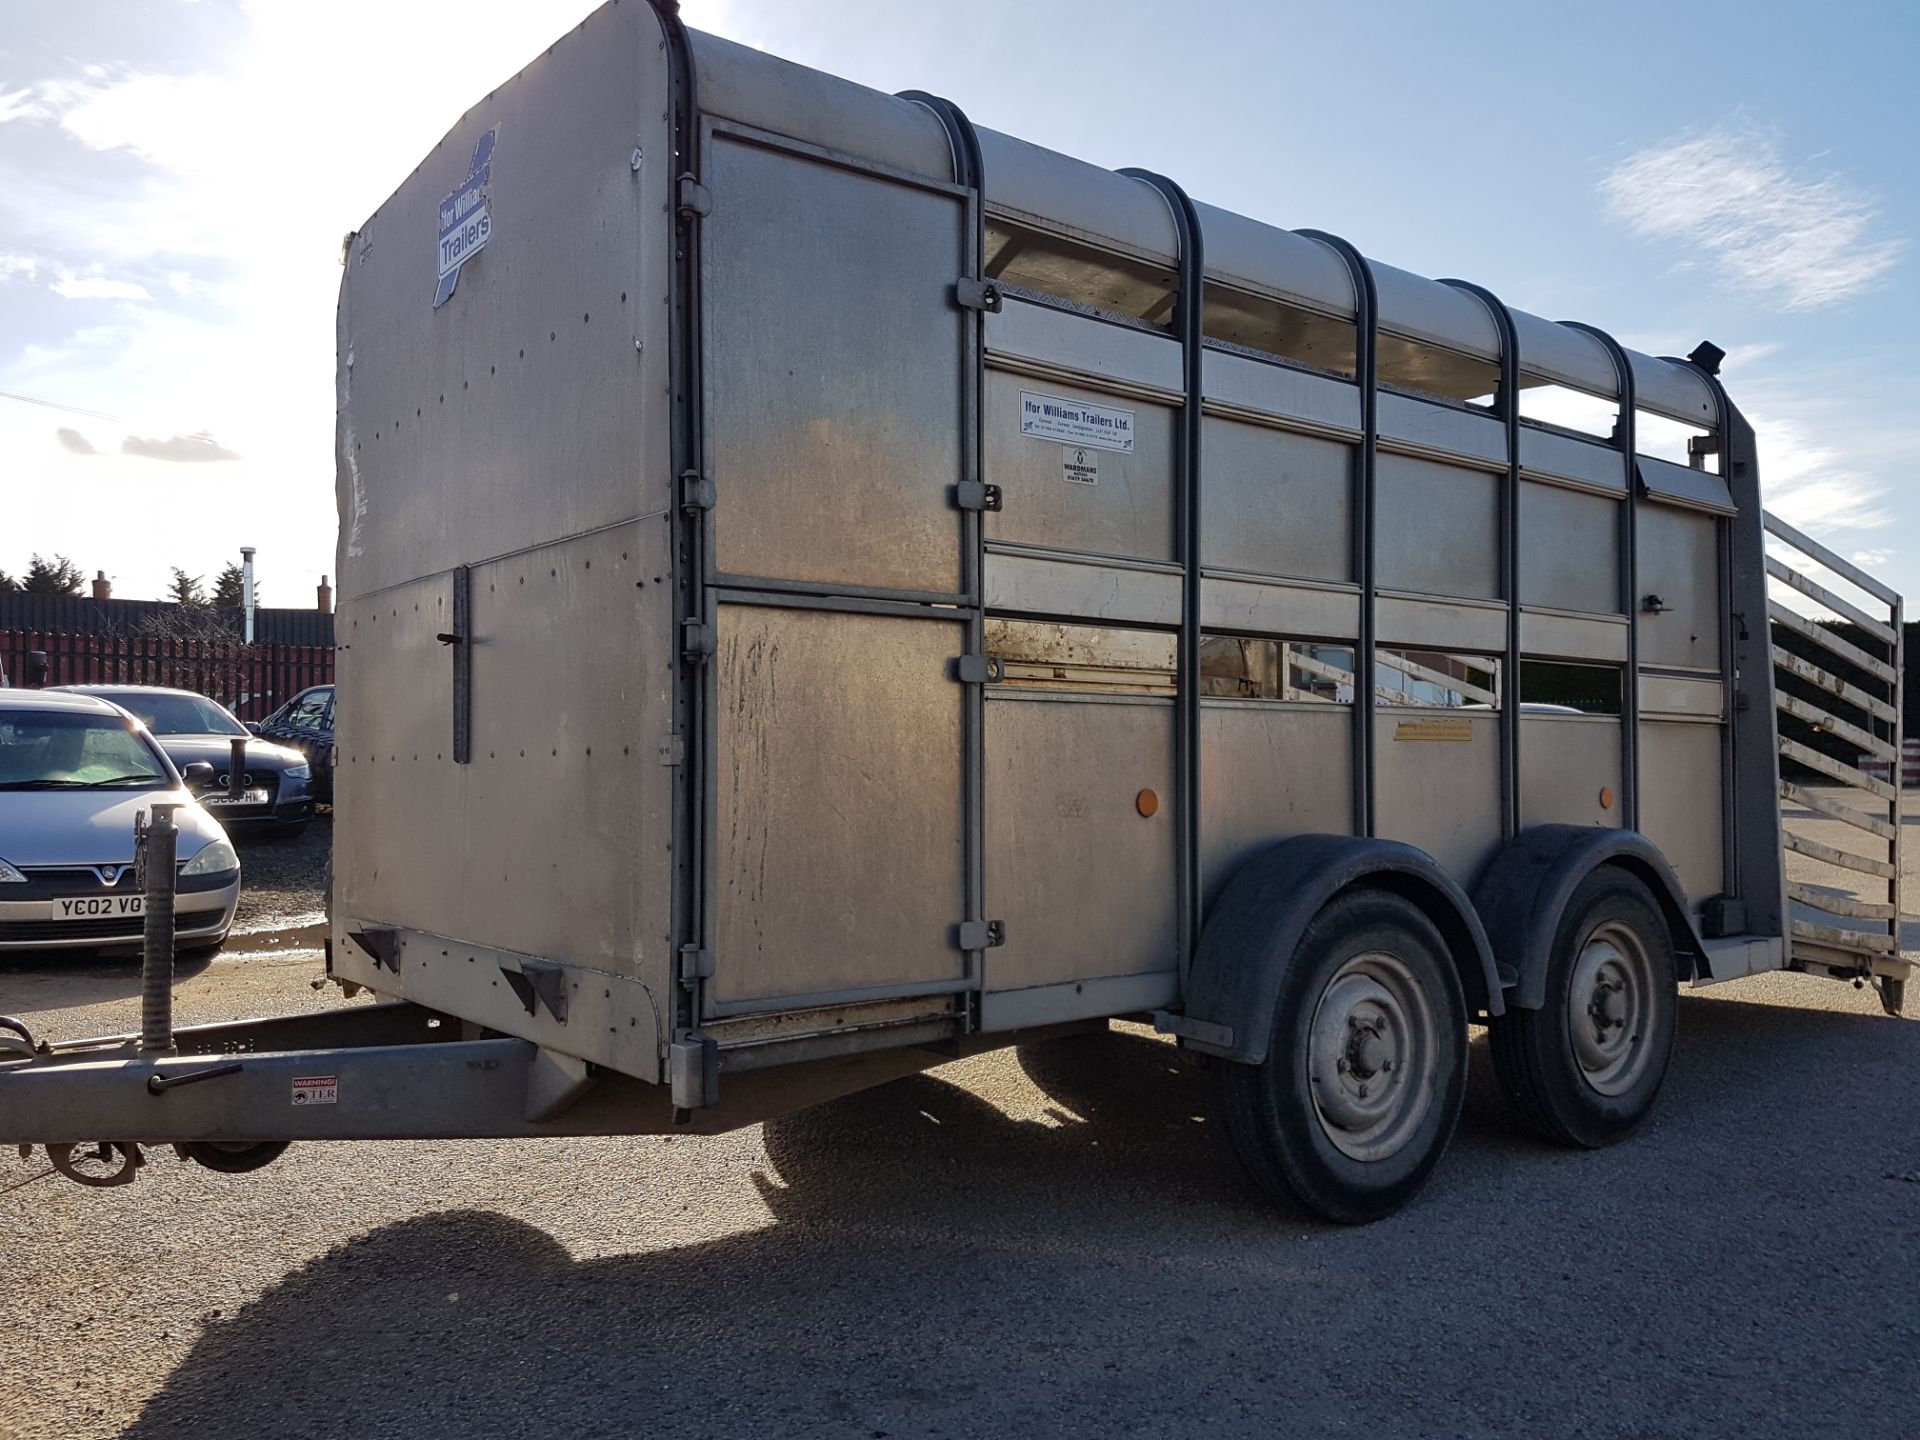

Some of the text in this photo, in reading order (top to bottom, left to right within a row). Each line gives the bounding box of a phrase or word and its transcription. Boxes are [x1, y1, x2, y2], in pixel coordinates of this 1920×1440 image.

[442, 214, 489, 264] Trailers
[1025, 401, 1040, 414] Ifor
[1043, 403, 1079, 421] Williams
[1082, 411, 1112, 427] Trailers
[1114, 417, 1130, 431] Ltd.
[1064, 464, 1097, 474] WARDMANS
[61, 898, 112, 916] YC02
[294, 1078, 335, 1087] WARNING!
